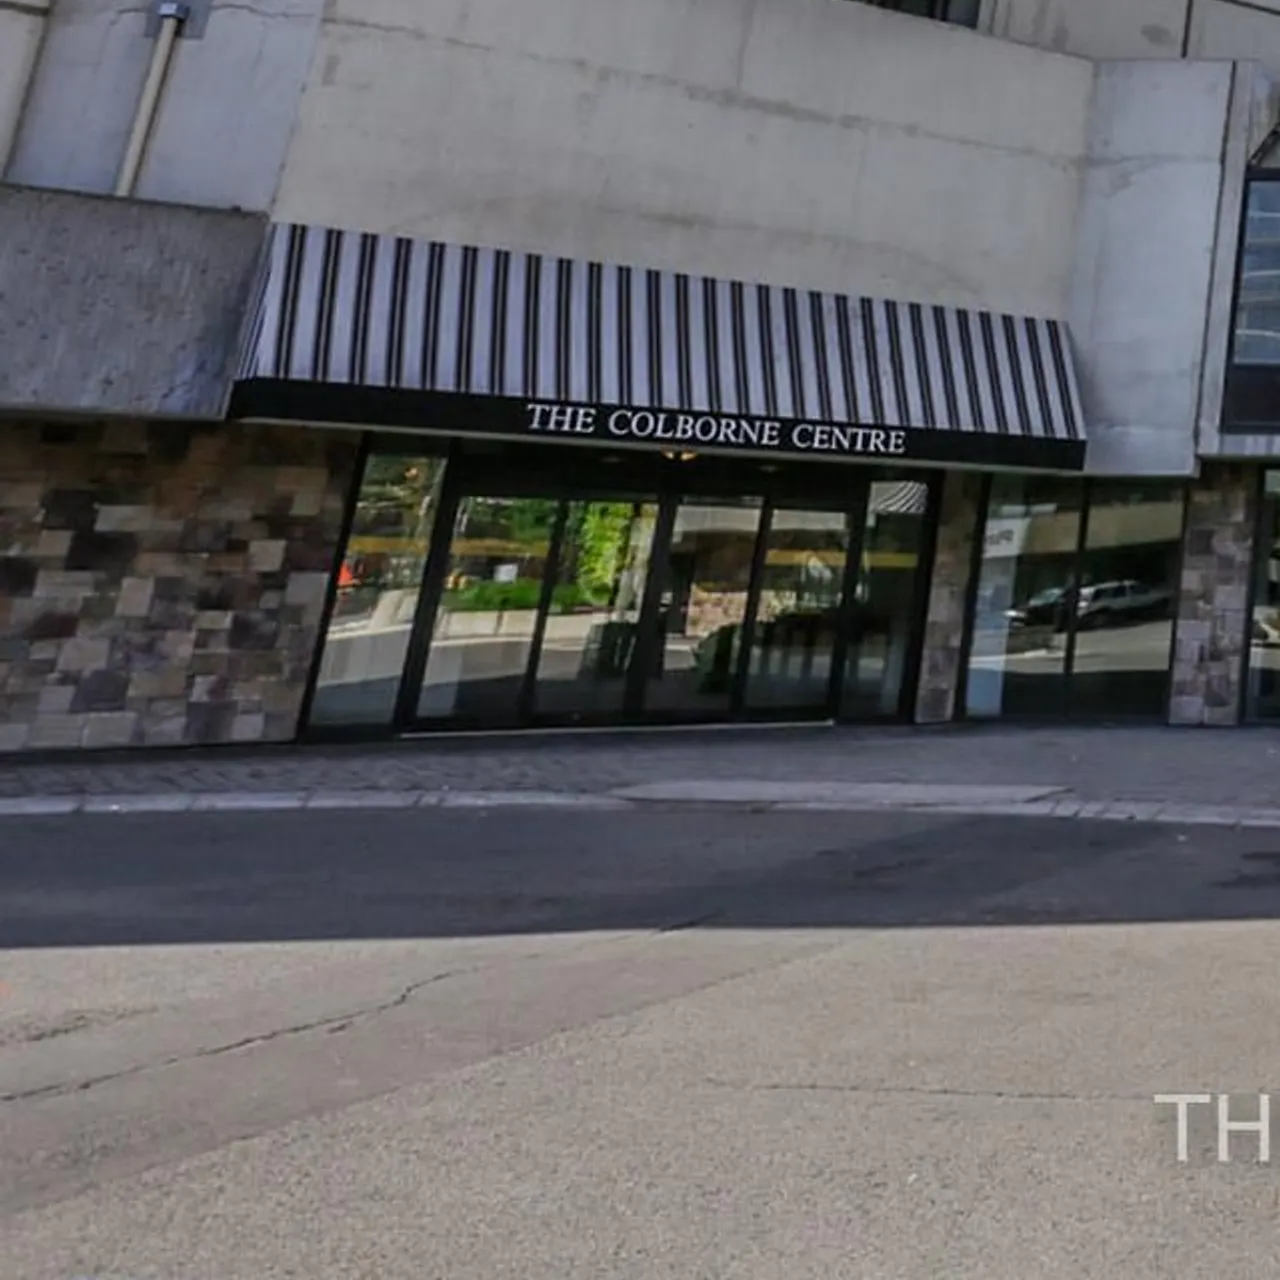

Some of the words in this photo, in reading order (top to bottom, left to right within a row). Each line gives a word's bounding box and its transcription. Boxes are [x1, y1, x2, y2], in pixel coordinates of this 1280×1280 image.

[527, 403, 596, 434] THE
[607, 410, 780, 446] COLBORNE
[791, 423, 906, 454] CENTRE
